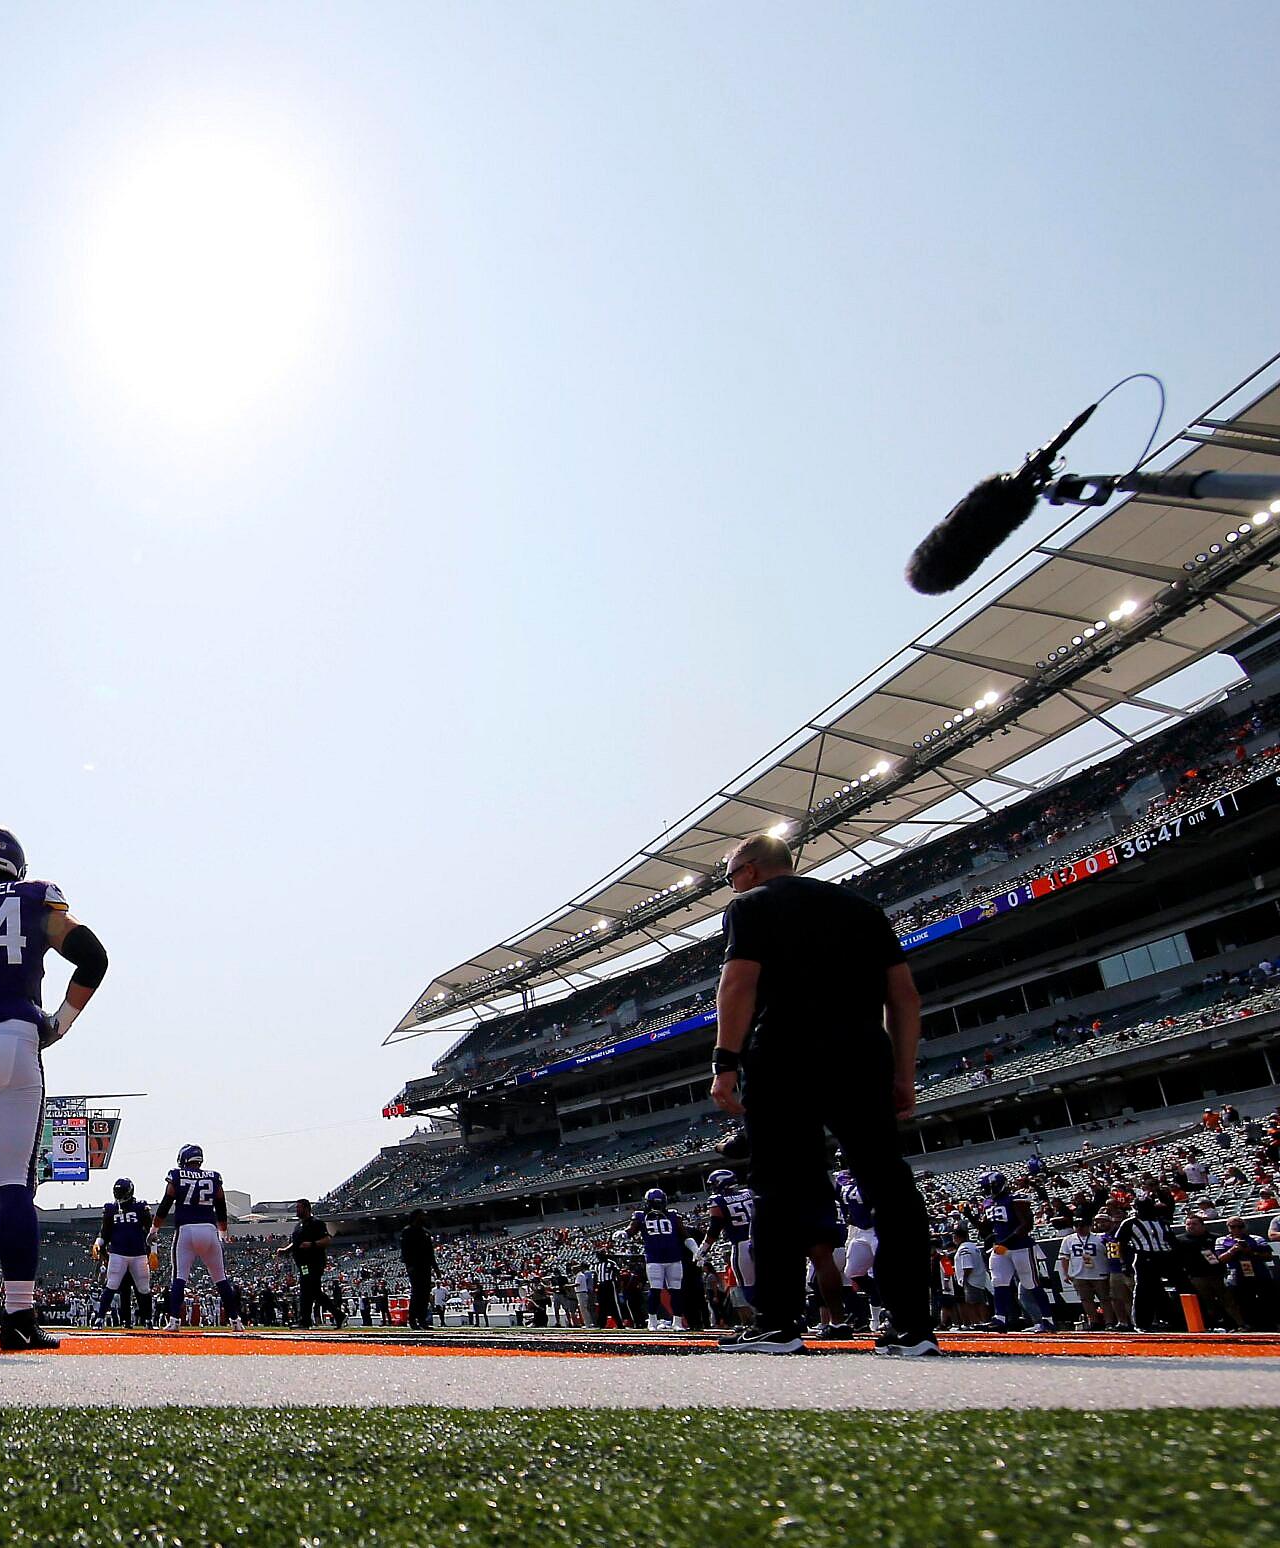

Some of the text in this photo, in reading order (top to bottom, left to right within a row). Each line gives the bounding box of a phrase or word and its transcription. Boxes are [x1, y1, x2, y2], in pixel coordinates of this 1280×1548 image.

[1188, 810, 1207, 826] QTR
[1211, 799, 1225, 817] 1
[1085, 857, 1099, 874] 0
[1007, 891, 1019, 907] 0
[913, 931, 929, 943] LIKE
[179, 1170, 215, 1178] CLEVELAND
[180, 1179, 214, 1205] 72
[984, 1205, 1008, 1222] 59
[645, 1218, 673, 1235] 90
[1071, 1243, 1097, 1257] 69
